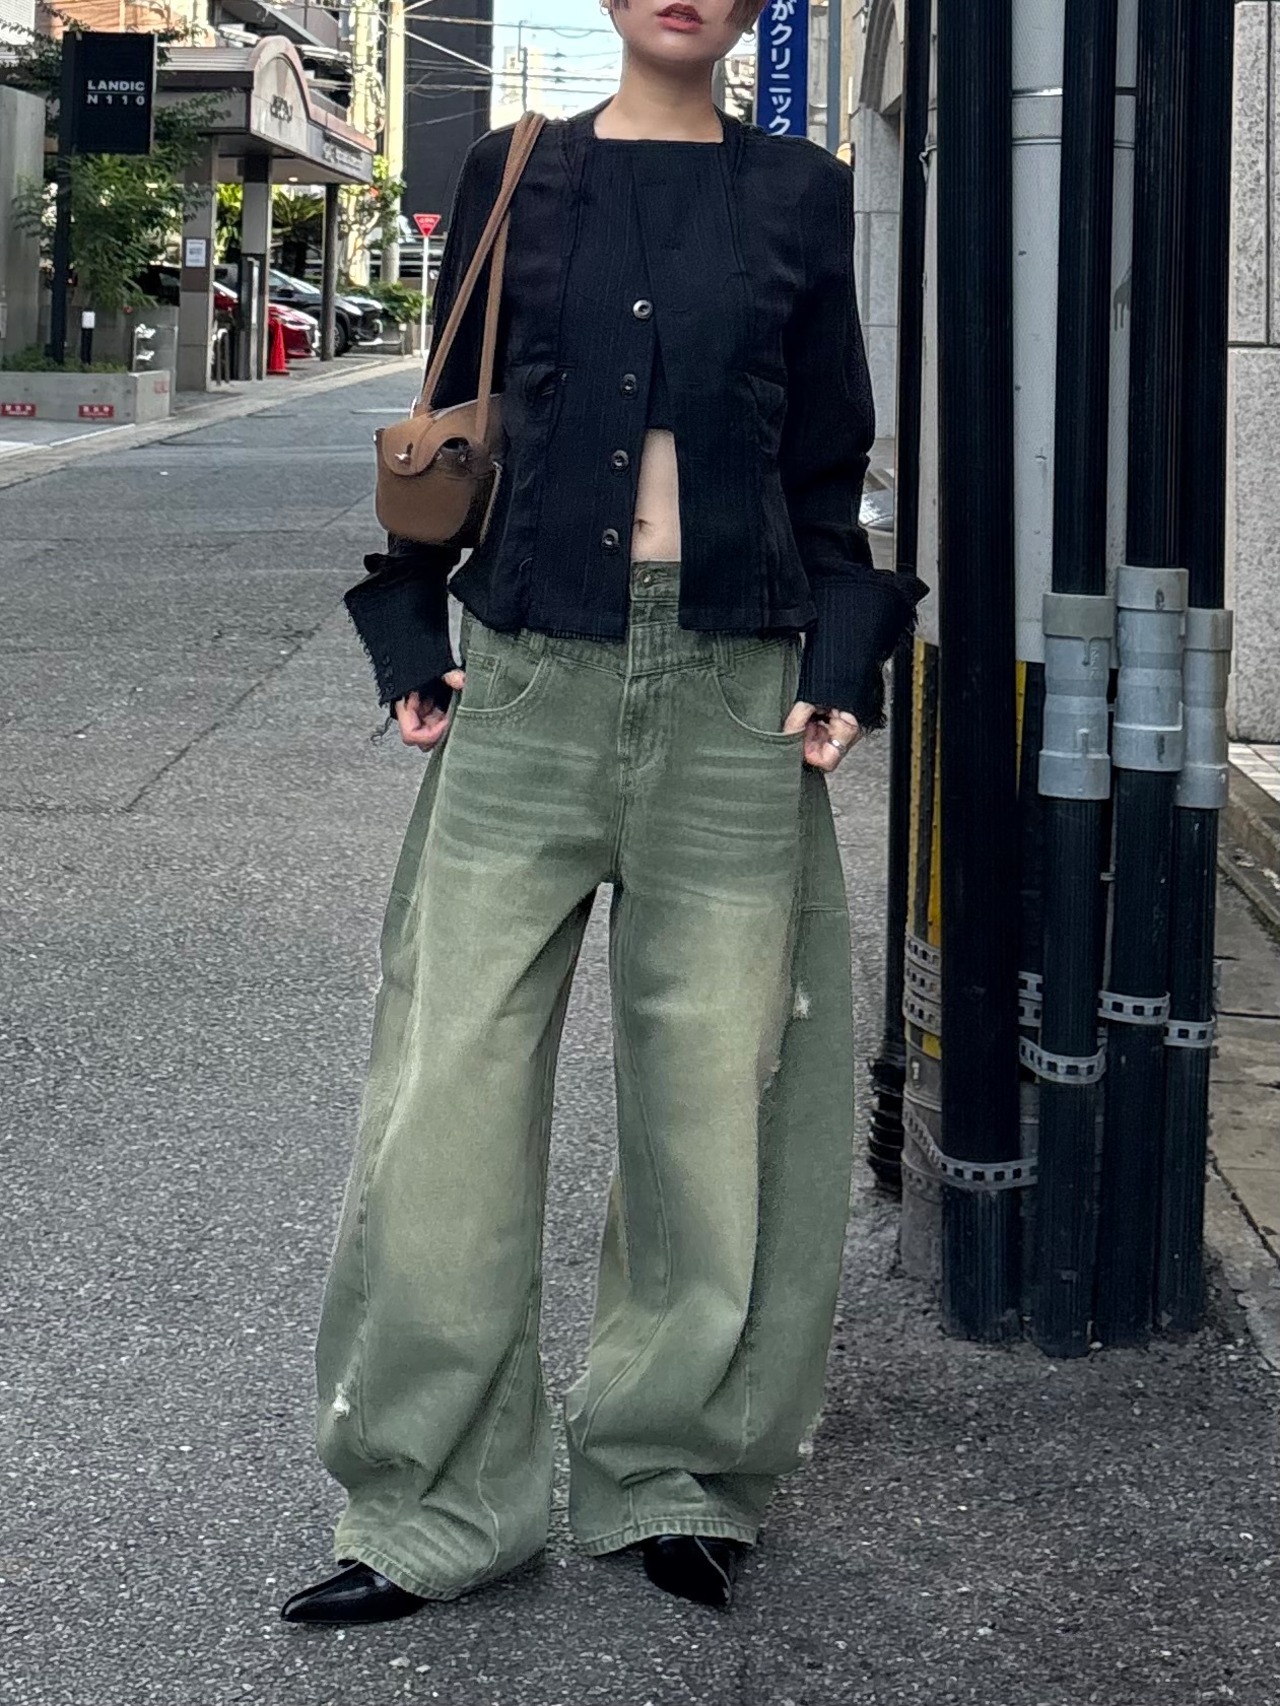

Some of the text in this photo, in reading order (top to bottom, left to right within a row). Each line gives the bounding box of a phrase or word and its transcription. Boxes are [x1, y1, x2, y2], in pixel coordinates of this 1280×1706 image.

[87, 80, 145, 91] LANDIC
[768, 0, 797, 135] がクリニック
